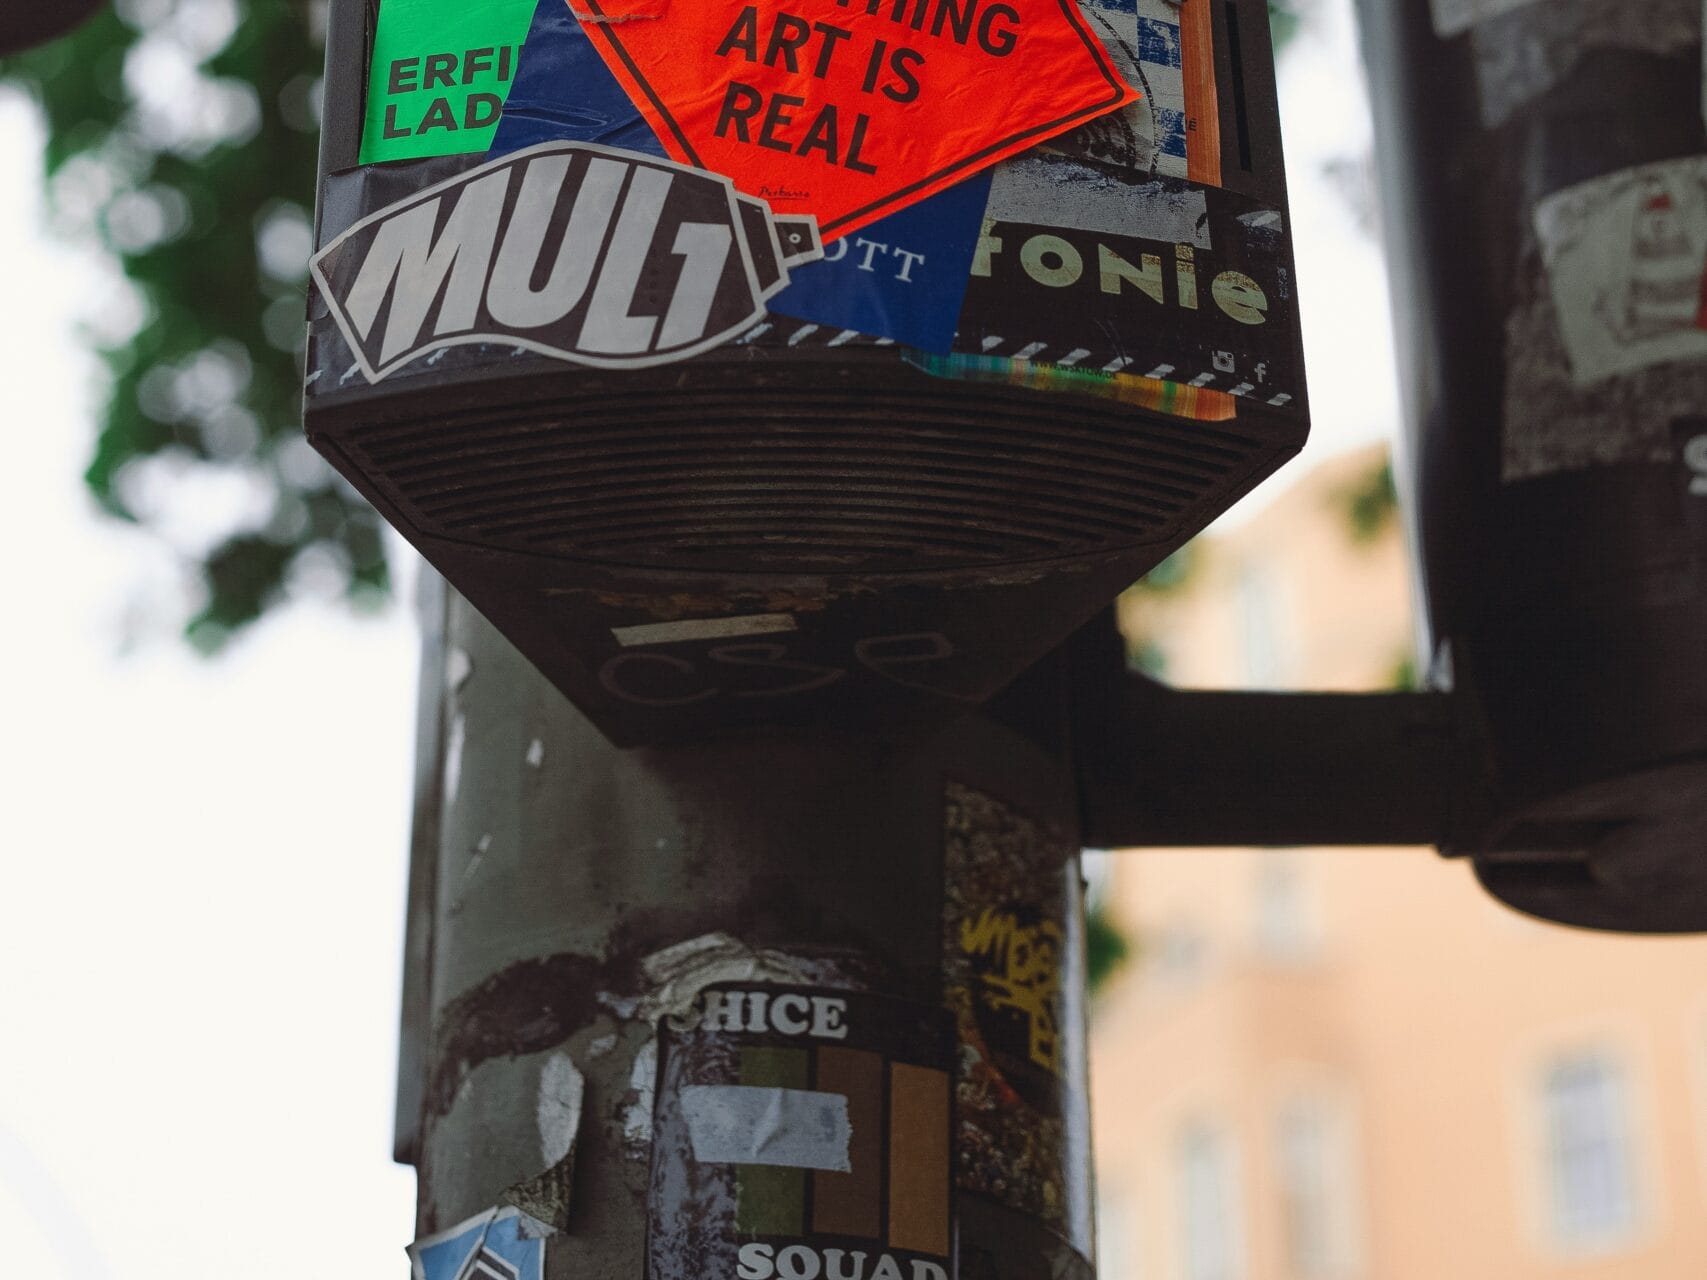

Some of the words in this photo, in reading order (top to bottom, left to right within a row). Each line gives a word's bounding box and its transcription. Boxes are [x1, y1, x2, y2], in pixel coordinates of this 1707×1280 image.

[387, 44, 526, 95] ERFI
[716, 5, 853, 80] ART
[861, 39, 927, 104] IS
[713, 81, 879, 176] REAL
[736, 1242, 950, 1280] SQUAD
